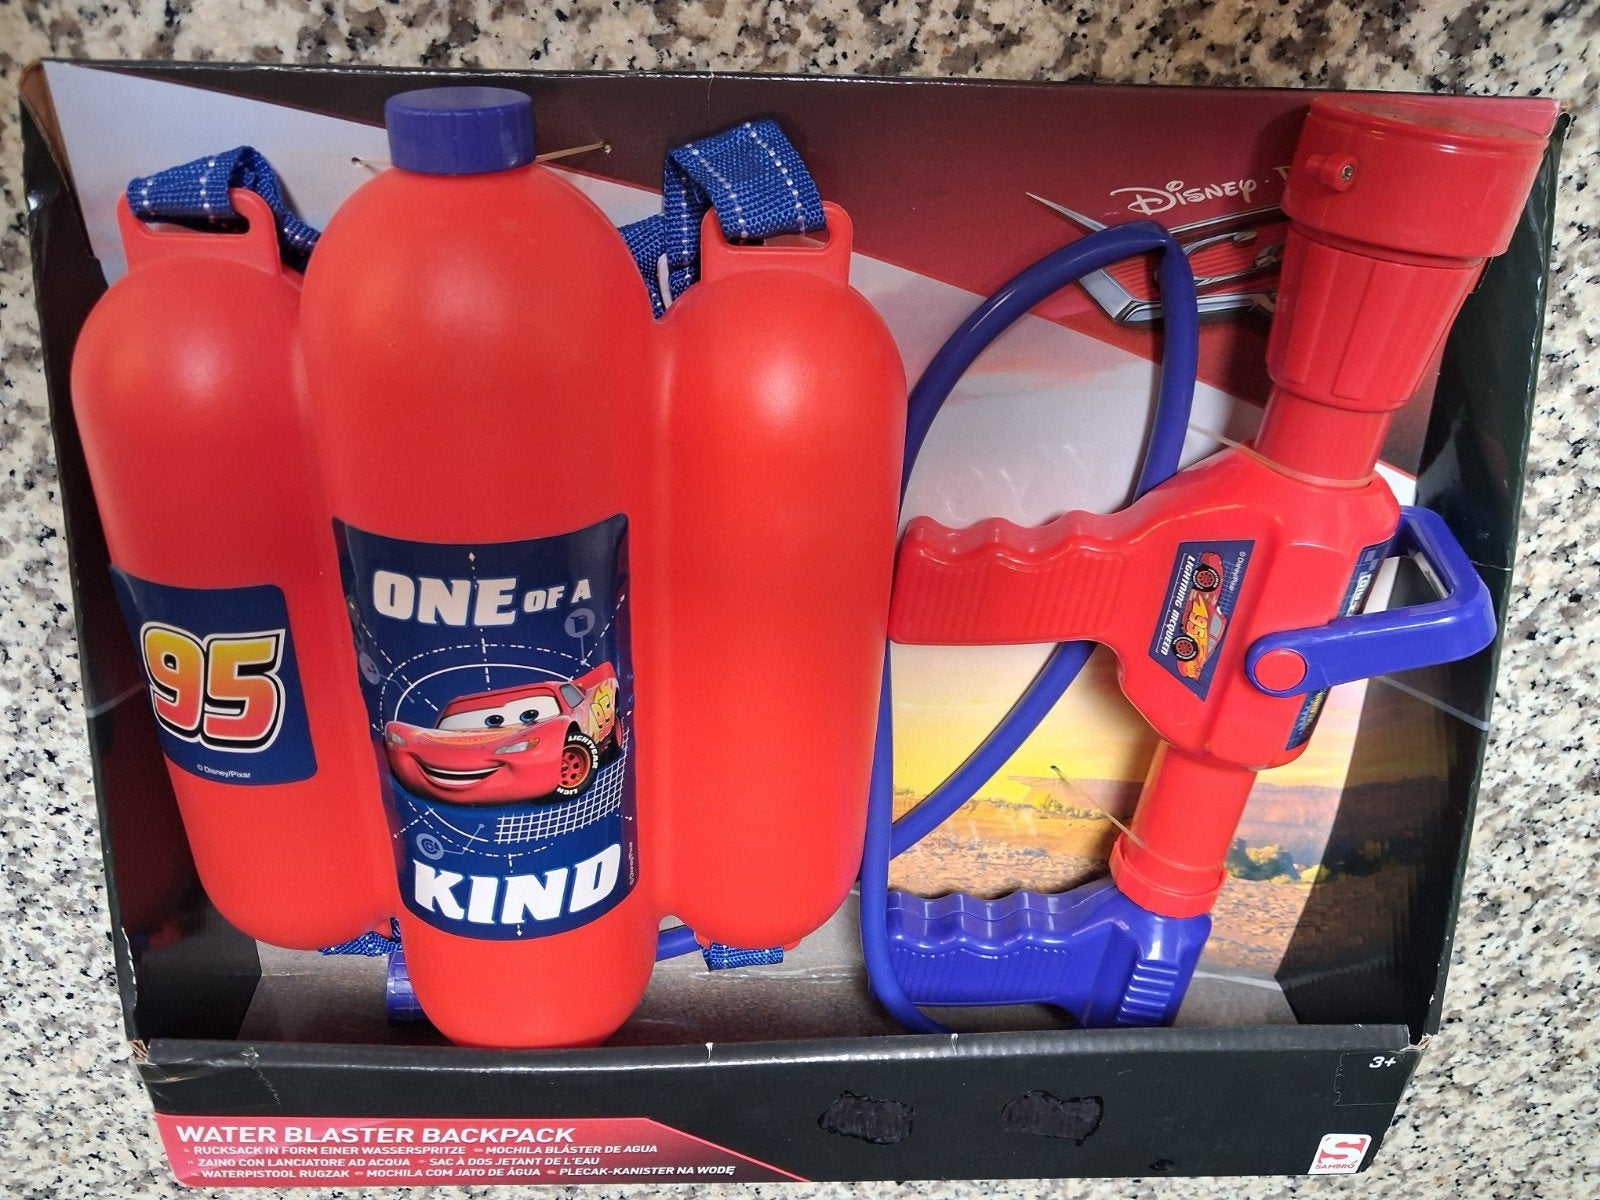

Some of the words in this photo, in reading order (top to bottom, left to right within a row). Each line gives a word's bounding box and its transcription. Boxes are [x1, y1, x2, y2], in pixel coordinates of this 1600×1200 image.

[1110, 179, 1257, 215] Disney
[372, 570, 518, 627] ONE
[523, 586, 564, 614] OF
[571, 580, 592, 604] A
[1186, 610, 1209, 640] 95
[140, 621, 286, 753] 95
[413, 843, 621, 926] KIND
[1368, 1056, 1397, 1069] 3+
[176, 1125, 277, 1143] WATER
[284, 1127, 414, 1143] BLASTER
[422, 1127, 577, 1143] BACKPACK
[193, 1146, 263, 1155] RUCKSACK
[265, 1146, 279, 1155] IN
[281, 1146, 318, 1155] FORM
[320, 1146, 359, 1155] EINER
[361, 1146, 467, 1155] WASSERSPRITZE
[485, 1146, 543, 1154] MOCHILA
[545, 1144, 602, 1154] BLÁSTER
[604, 1145, 621, 1154] DE
[623, 1145, 658, 1153] AGUA
[198, 1158, 236, 1167] ZAINO
[238, 1158, 265, 1167] CON
[267, 1158, 346, 1167] LANCIATORE
[347, 1158, 366, 1167] AD
[368, 1158, 411, 1167] ACQUA
[429, 1158, 454, 1166] SAC
[456, 1156, 465, 1166] À
[467, 1157, 493, 1166] DOS
[495, 1157, 543, 1166] JETANT
[544, 1157, 561, 1166] DE
[201, 1170, 296, 1178] WATERPISTOOL
[299, 1170, 350, 1178] RUGZAK
[366, 1169, 423, 1178] MOCHILA
[425, 1169, 453, 1177] COM
[455, 1168, 486, 1177] JATO
[487, 1168, 505, 1177] DE
[506, 1166, 541, 1177] ÁGUA
[559, 1166, 674, 1176] PLECAK-KANISTER
[676, 1166, 693, 1175] NA
[697, 1165, 736, 1176] WODĘ
